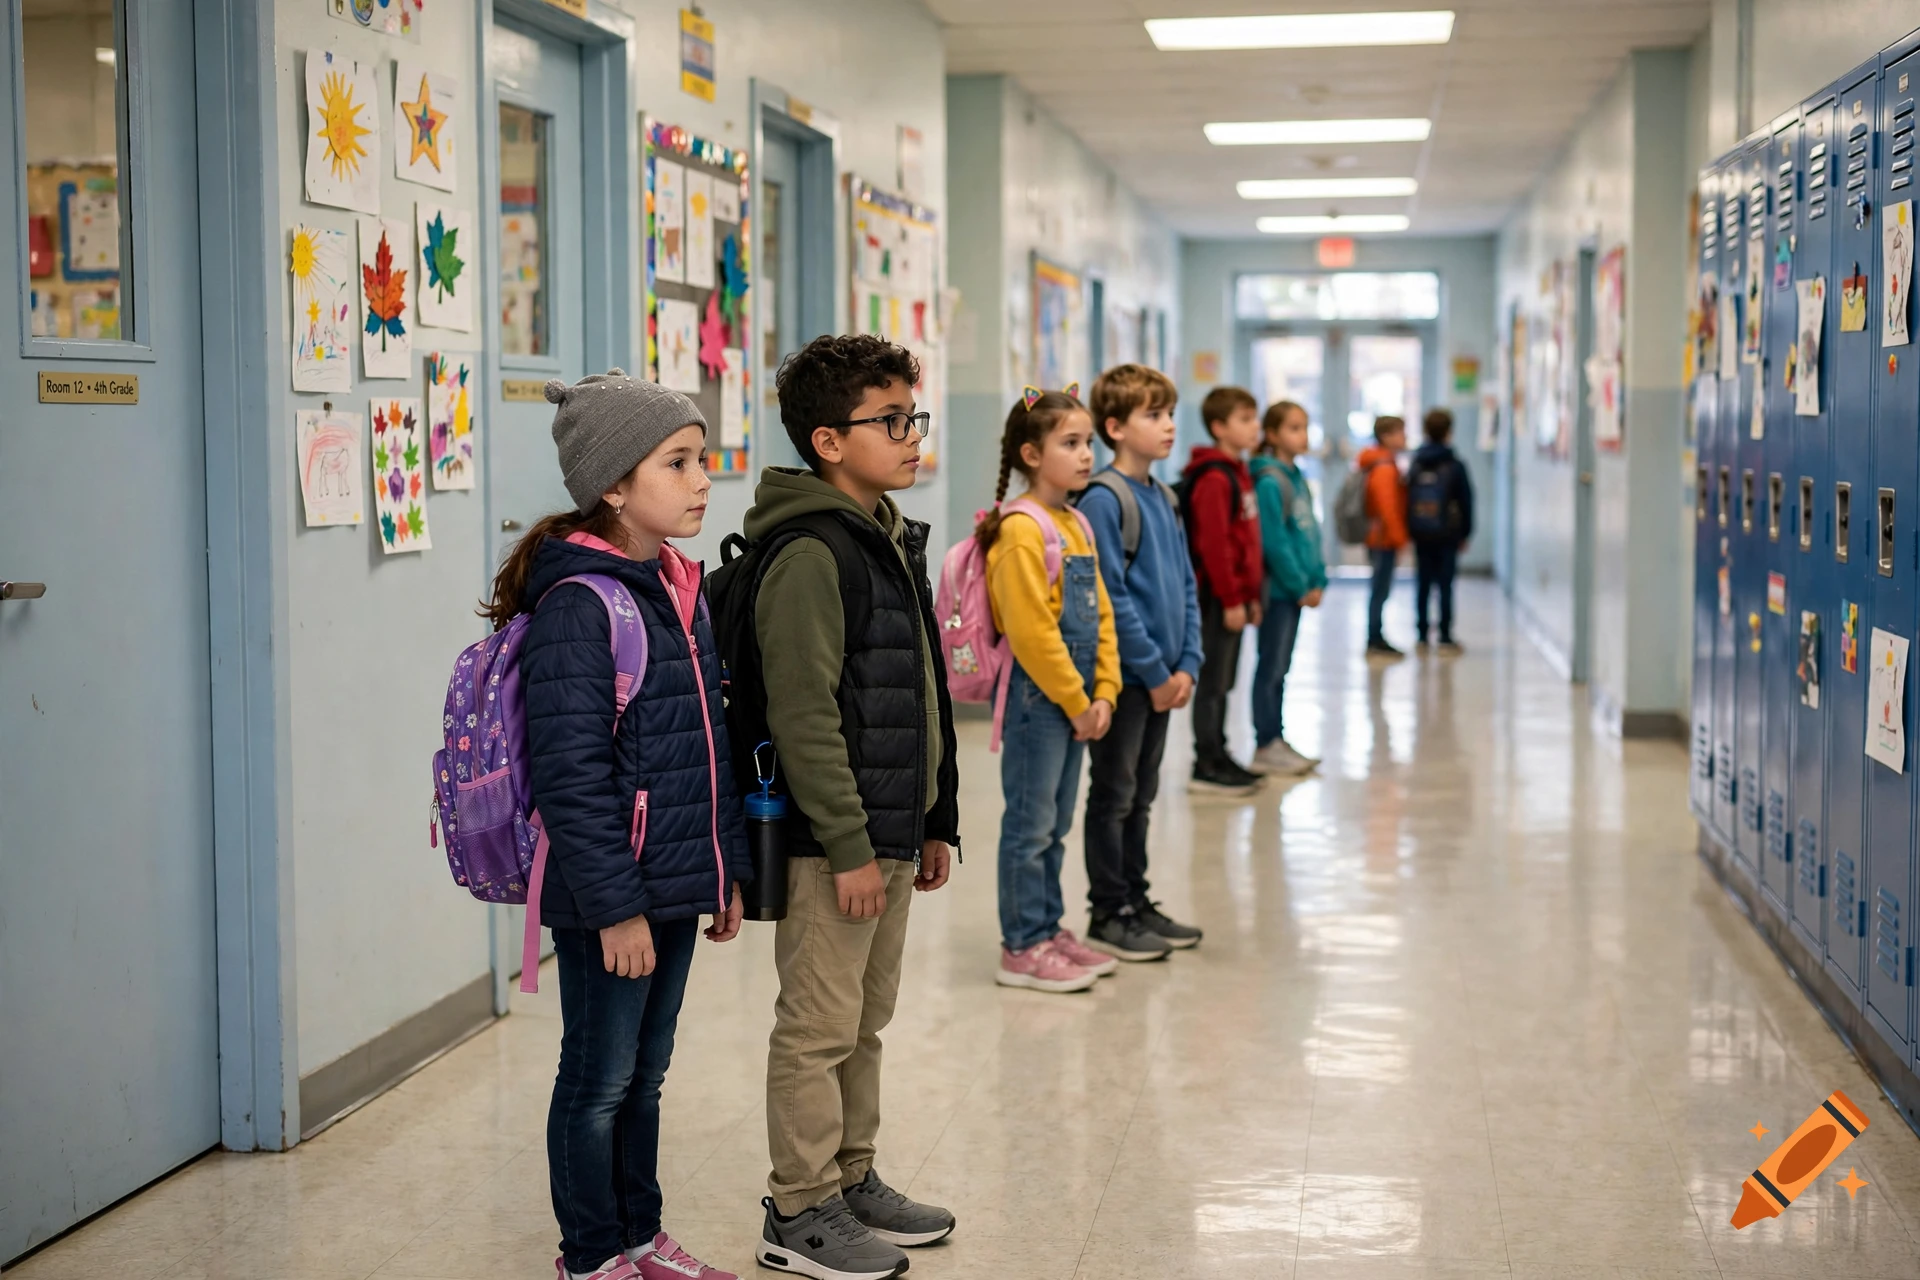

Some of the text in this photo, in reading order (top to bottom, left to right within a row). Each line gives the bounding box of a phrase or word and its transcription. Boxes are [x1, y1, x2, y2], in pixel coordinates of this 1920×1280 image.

[46, 379, 134, 395] Room 12 4th Grade
